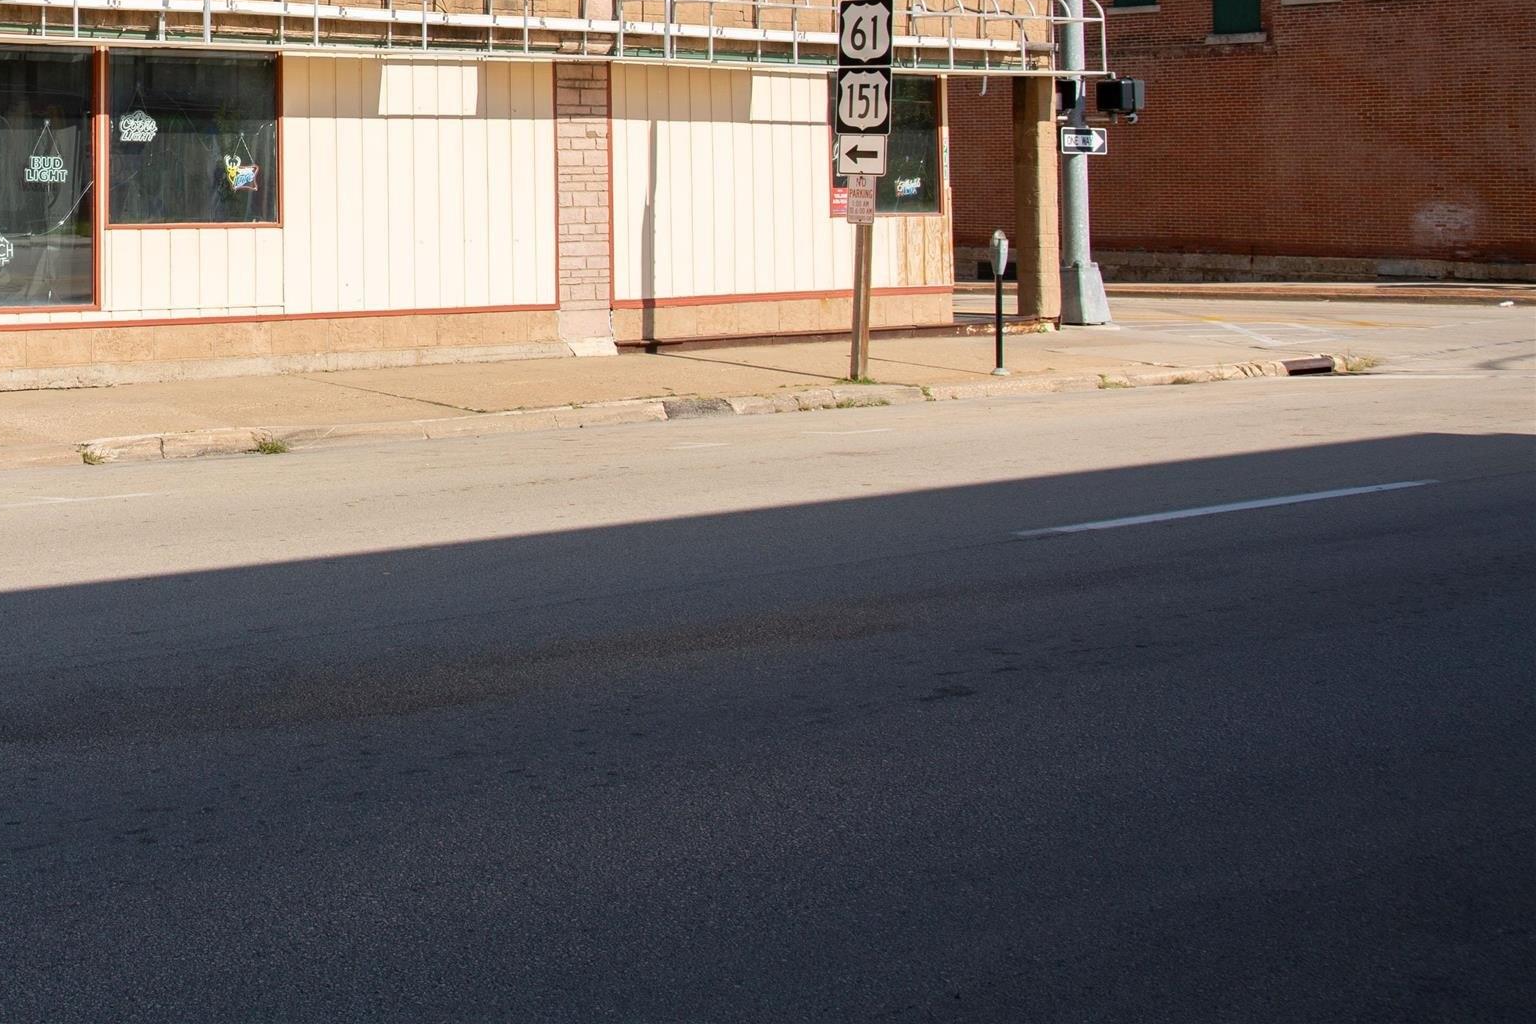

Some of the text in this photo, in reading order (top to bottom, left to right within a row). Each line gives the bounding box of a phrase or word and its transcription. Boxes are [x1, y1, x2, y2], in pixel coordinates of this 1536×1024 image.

[851, 15, 878, 51] 61
[847, 83, 879, 118] 151
[1067, 136, 1093, 146] ONE WAY
[30, 155, 64, 170] BUD
[25, 169, 68, 183] LIGHT
[856, 177, 867, 187] NO
[849, 188, 873, 198] PARKING
